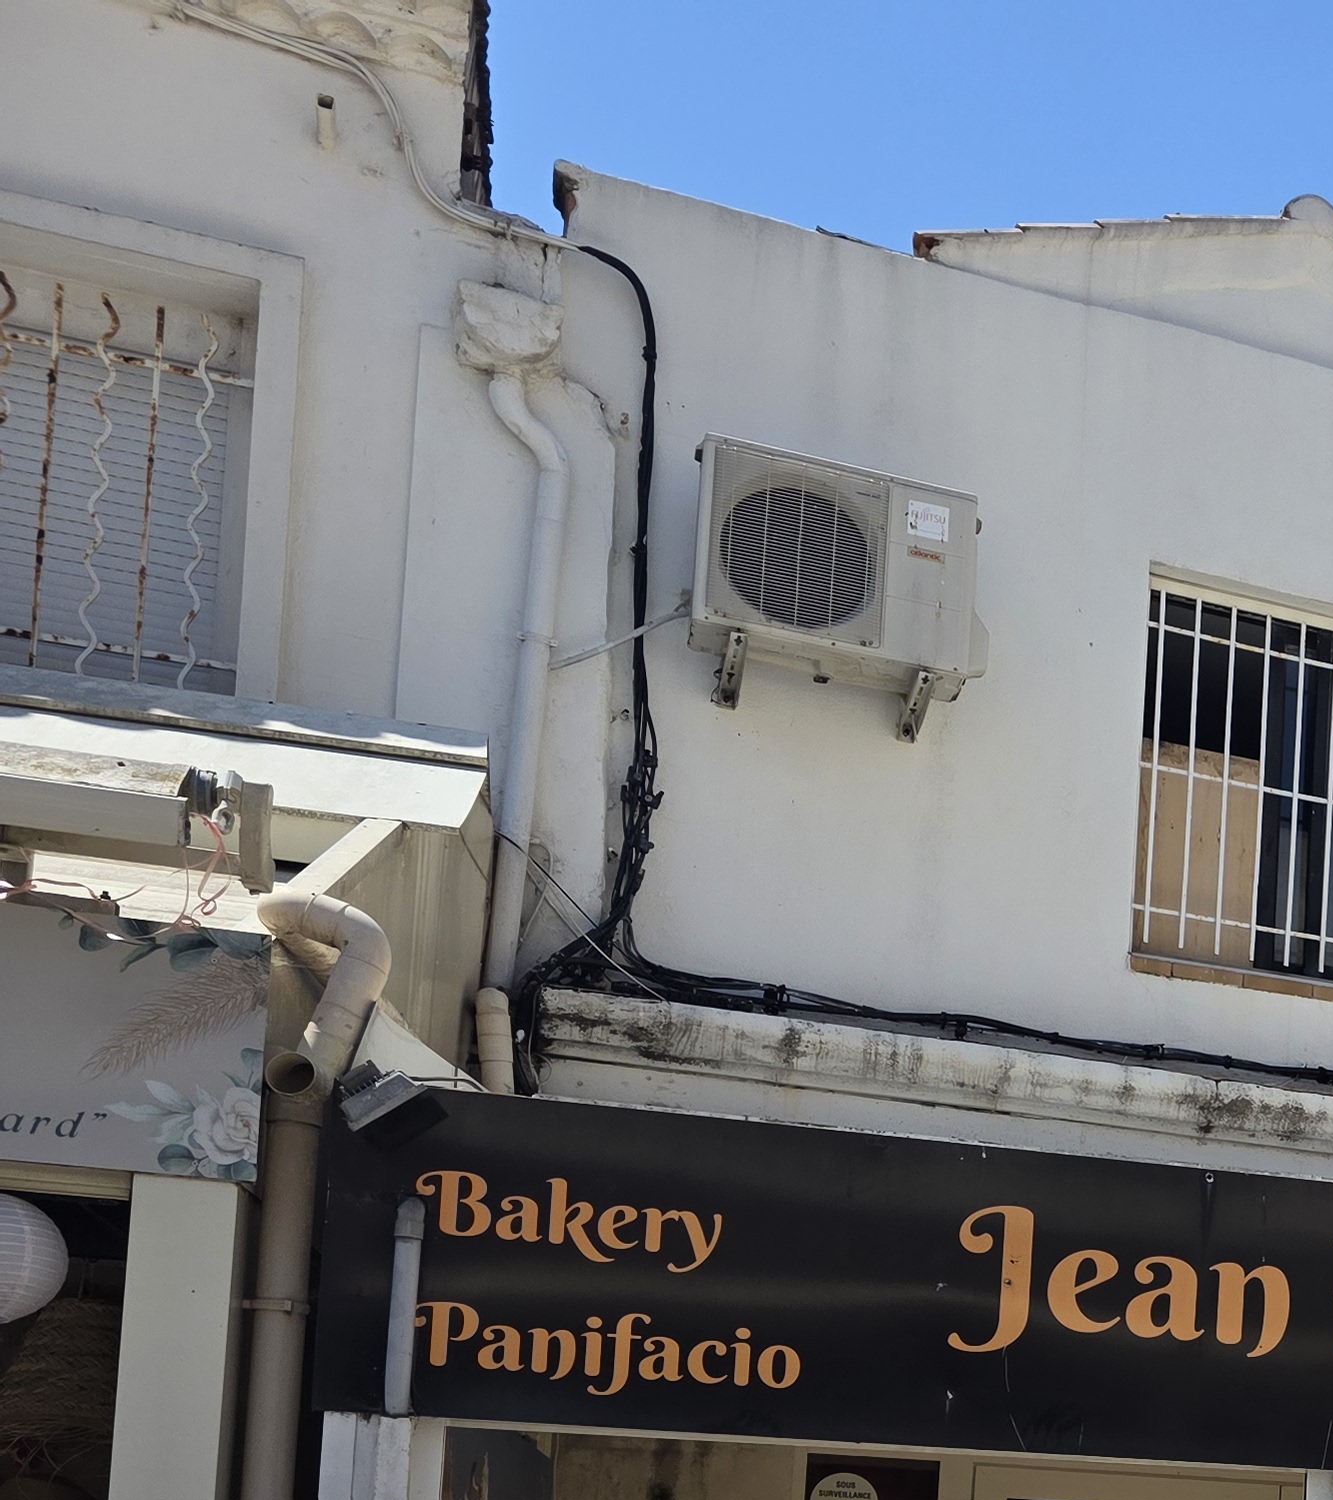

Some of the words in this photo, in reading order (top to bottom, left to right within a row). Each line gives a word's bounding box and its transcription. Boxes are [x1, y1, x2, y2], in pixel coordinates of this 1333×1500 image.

[415, 1170, 723, 1273] Bakery
[947, 1205, 1291, 1358] Jean
[414, 1301, 801, 1396] Panifacio
[818, 1489, 871, 1500] SURVEILLANCE
[836, 1481, 856, 1489] SOUS
